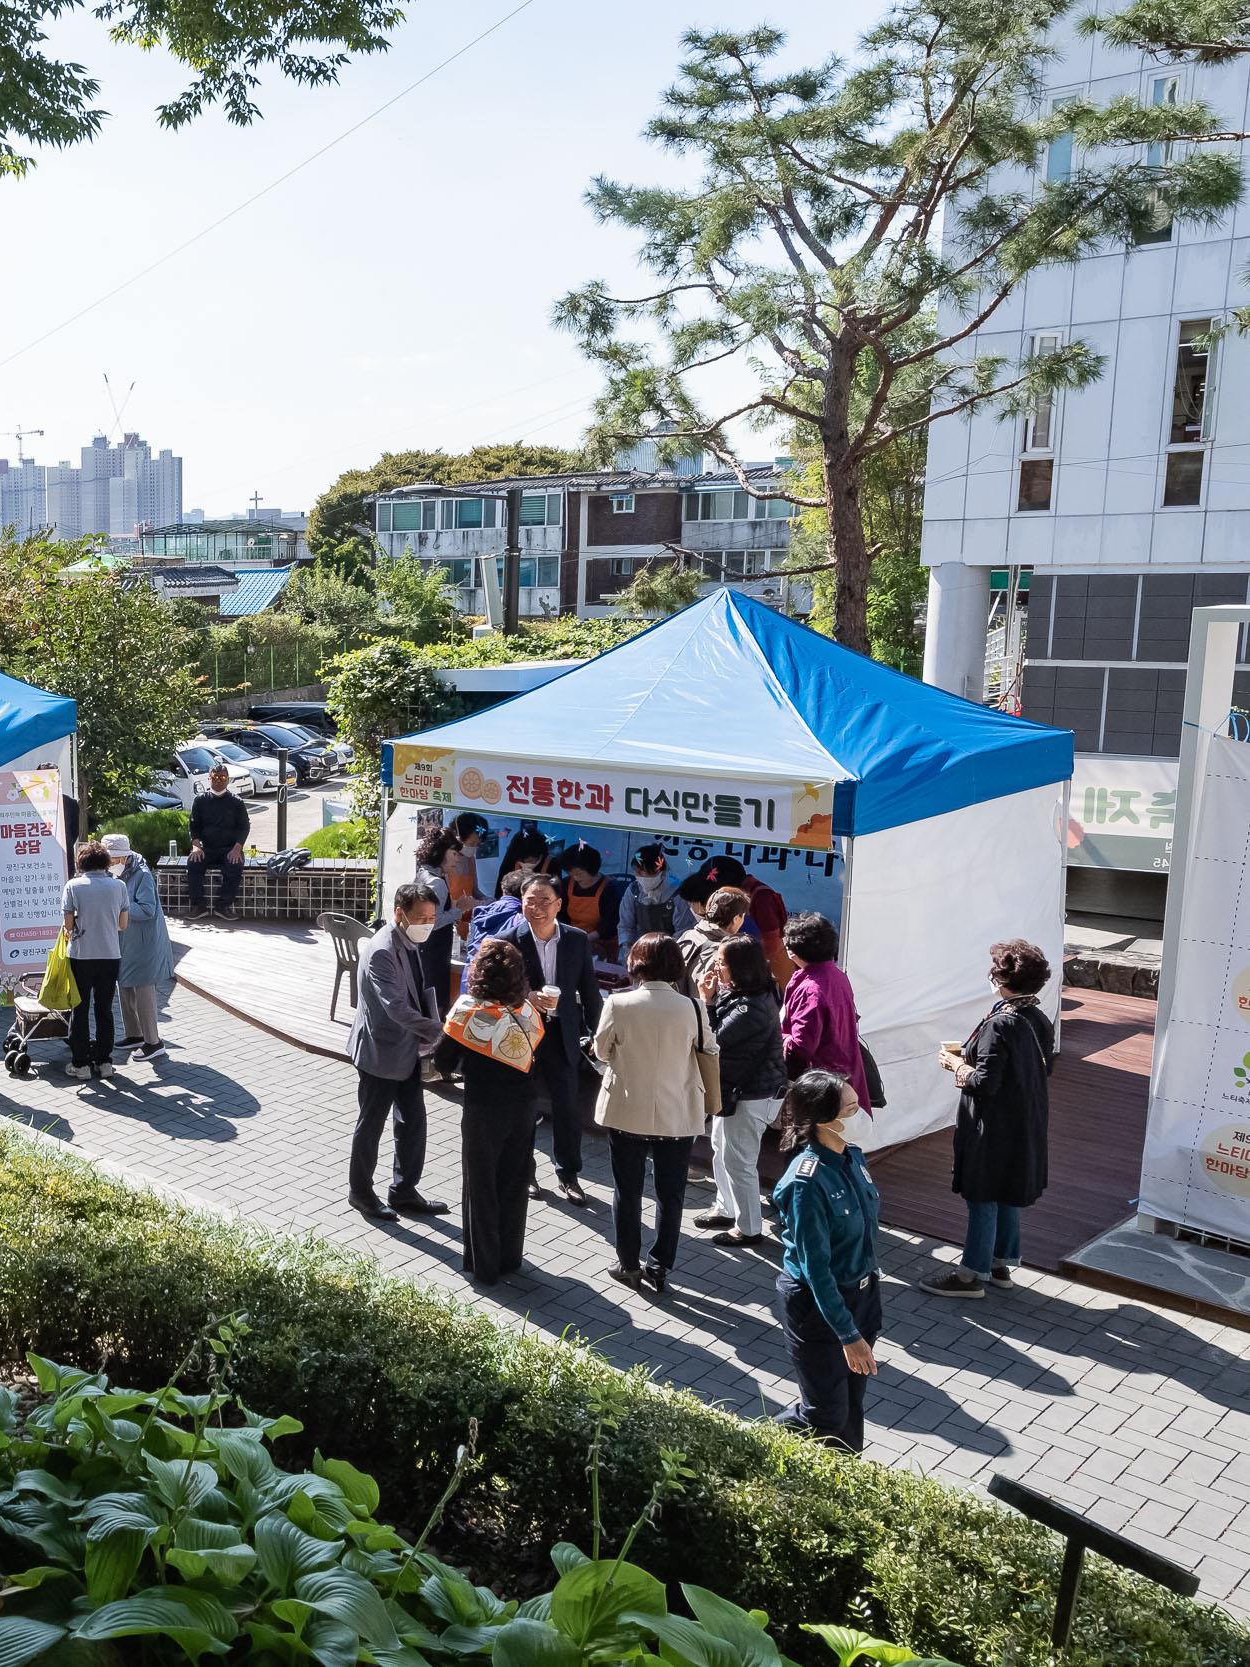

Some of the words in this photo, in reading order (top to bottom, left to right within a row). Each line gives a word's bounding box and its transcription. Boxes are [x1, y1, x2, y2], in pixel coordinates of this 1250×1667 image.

[414, 763, 433, 772] 제9회
[405, 774, 442, 788] 느티마을
[400, 786, 428, 800] 한마당
[432, 790, 452, 802] 축제
[506, 775, 614, 814] 전통한과
[625, 787, 775, 831] 다식만들기
[0, 822, 53, 839] 마음건강
[14, 840, 41, 855] 상담
[6, 862, 53, 871] 광진구보건소는
[1, 875, 21, 883] 마음의
[24, 874, 37, 882] 감기
[40, 872, 59, 881] 우울증
[2, 887, 22, 895] 예방과
[25, 886, 44, 894] 탈출을
[47, 885, 61, 893] 위해
[3, 899, 30, 908] 선별검사
[42, 897, 61, 905] 상담을
[4, 912, 24, 920] 무료로
